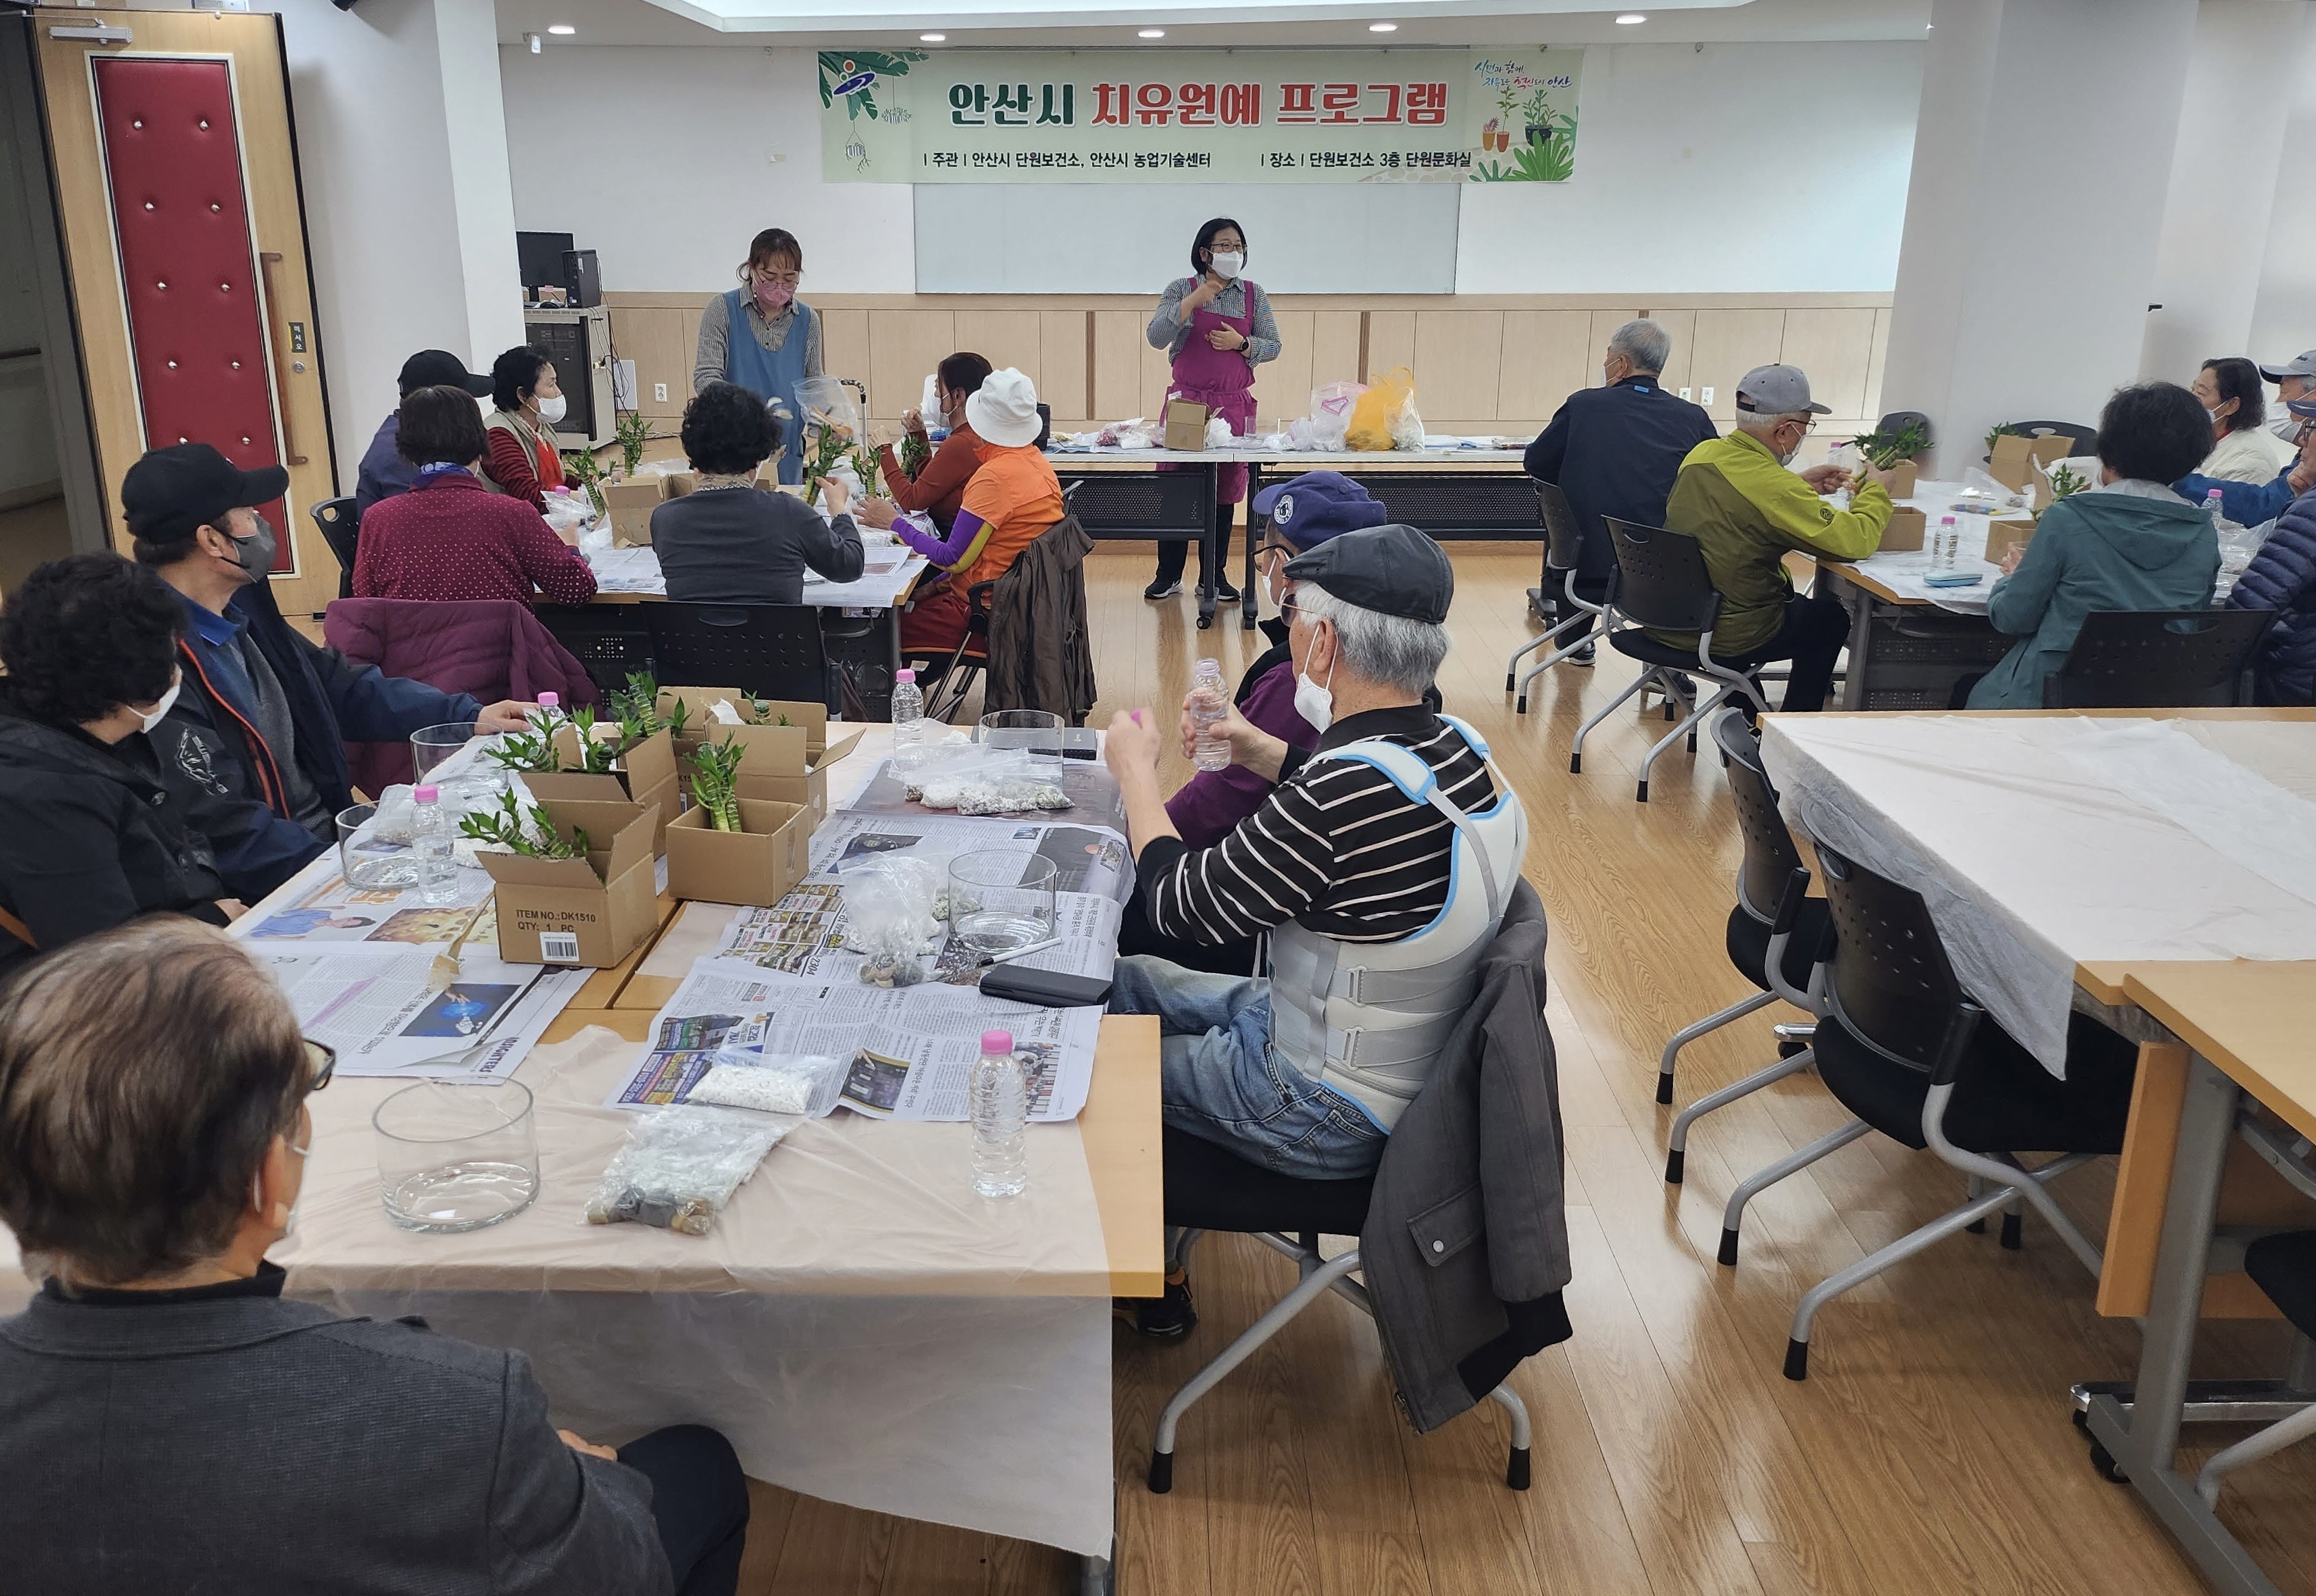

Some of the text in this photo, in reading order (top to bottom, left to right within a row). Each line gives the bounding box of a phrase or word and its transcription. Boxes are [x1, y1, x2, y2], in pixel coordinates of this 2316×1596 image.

[1474, 59, 1502, 77] 시민과
[1513, 76, 1544, 89] 혁신도시
[1548, 76, 1572, 88] 안산
[949, 82, 1447, 126] 안산시 치유원예 프로그램
[932, 152, 1211, 168] 주관 안산시 단원보건소, 안산시 농업기술센터
[1269, 151, 1471, 168] 장소 단원보건소 3층 단원문화실
[294, 326, 303, 350] 미시오
[516, 909, 538, 919] ITEM
[518, 921, 574, 933] QTY: 1 PC
